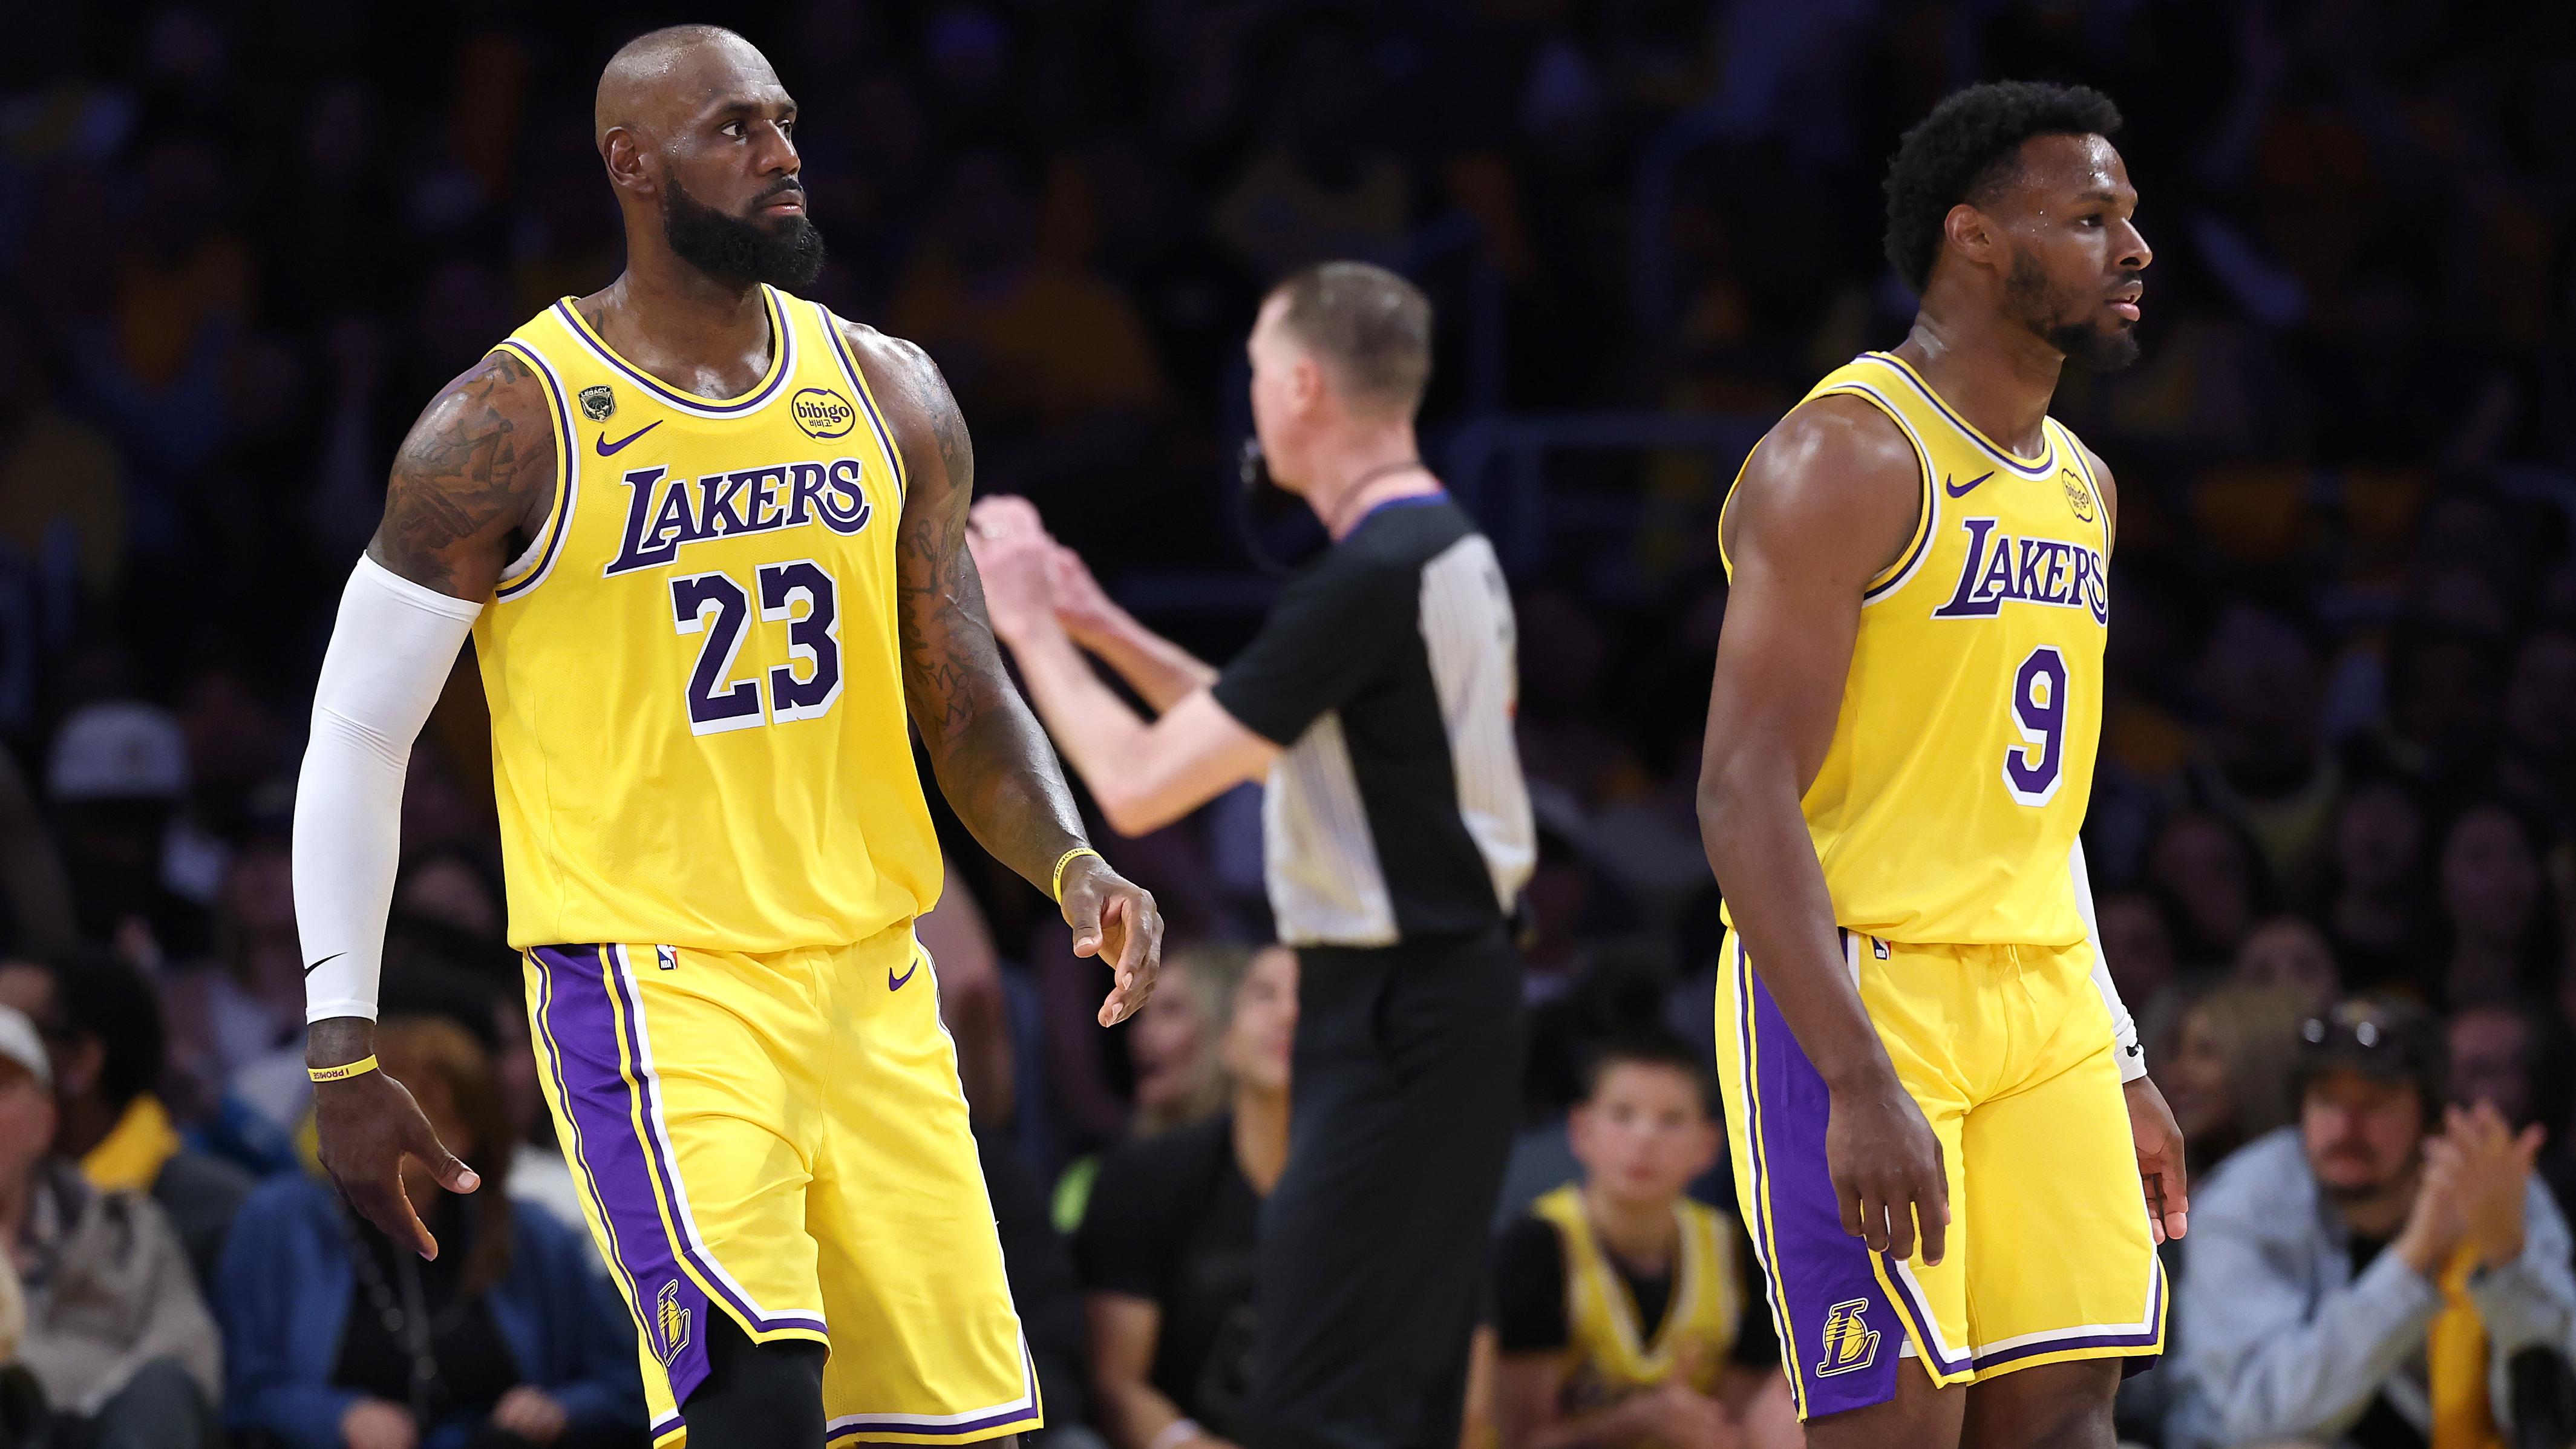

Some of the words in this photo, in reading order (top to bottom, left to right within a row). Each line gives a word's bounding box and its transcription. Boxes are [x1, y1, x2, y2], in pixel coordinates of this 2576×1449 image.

[581, 387, 607, 397] LEGACY
[796, 401, 850, 423] bibigo
[603, 457, 872, 578] LAKERS
[1930, 515, 2108, 628] LAKERS
[668, 558, 844, 736] 23
[2001, 643, 2070, 807] 9
[660, 959, 672, 969] NBA
[313, 1069, 344, 1080] PROMISE
